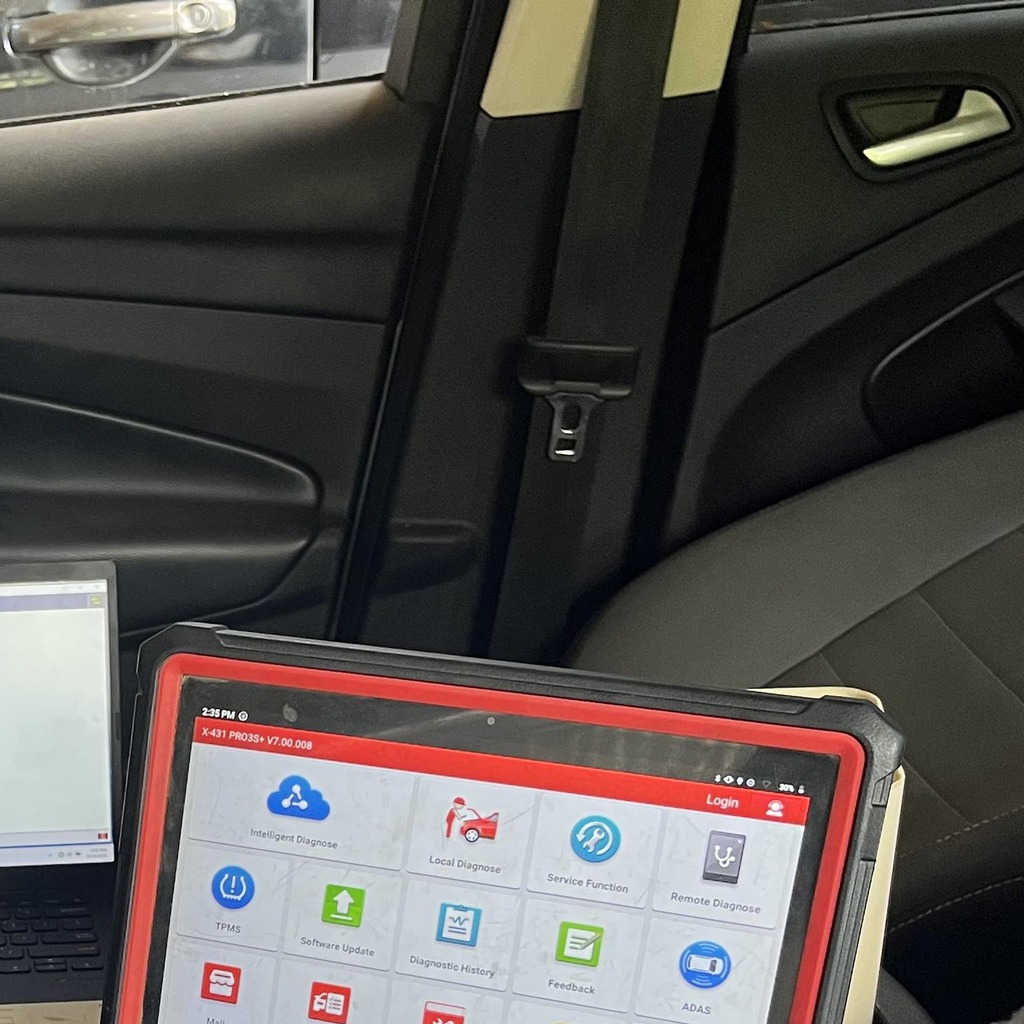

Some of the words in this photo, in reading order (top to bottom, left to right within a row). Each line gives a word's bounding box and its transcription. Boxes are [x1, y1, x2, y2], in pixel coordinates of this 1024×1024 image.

[201, 706, 221, 719] 2:35
[221, 708, 236, 720] PM
[201, 726, 227, 740] X-431
[228, 730, 266, 745] PRO3S+
[266, 735, 313, 751] V7.00.008
[706, 793, 740, 809] Login
[250, 828, 295, 844] Intelligent
[296, 834, 339, 850] Diagnose
[429, 855, 455, 868] Local
[457, 860, 502, 875] Diagnose
[547, 873, 584, 888] Service
[585, 878, 629, 893] Function
[670, 892, 711, 907] Remote
[712, 897, 762, 915] Diagnose
[215, 921, 242, 934] TPMS
[301, 936, 341, 951] Software
[342, 943, 375, 958] Update
[409, 955, 460, 973] Diagnostic
[461, 963, 496, 979] History
[548, 979, 596, 995] Feedback
[681, 1002, 712, 1016] ADAS
